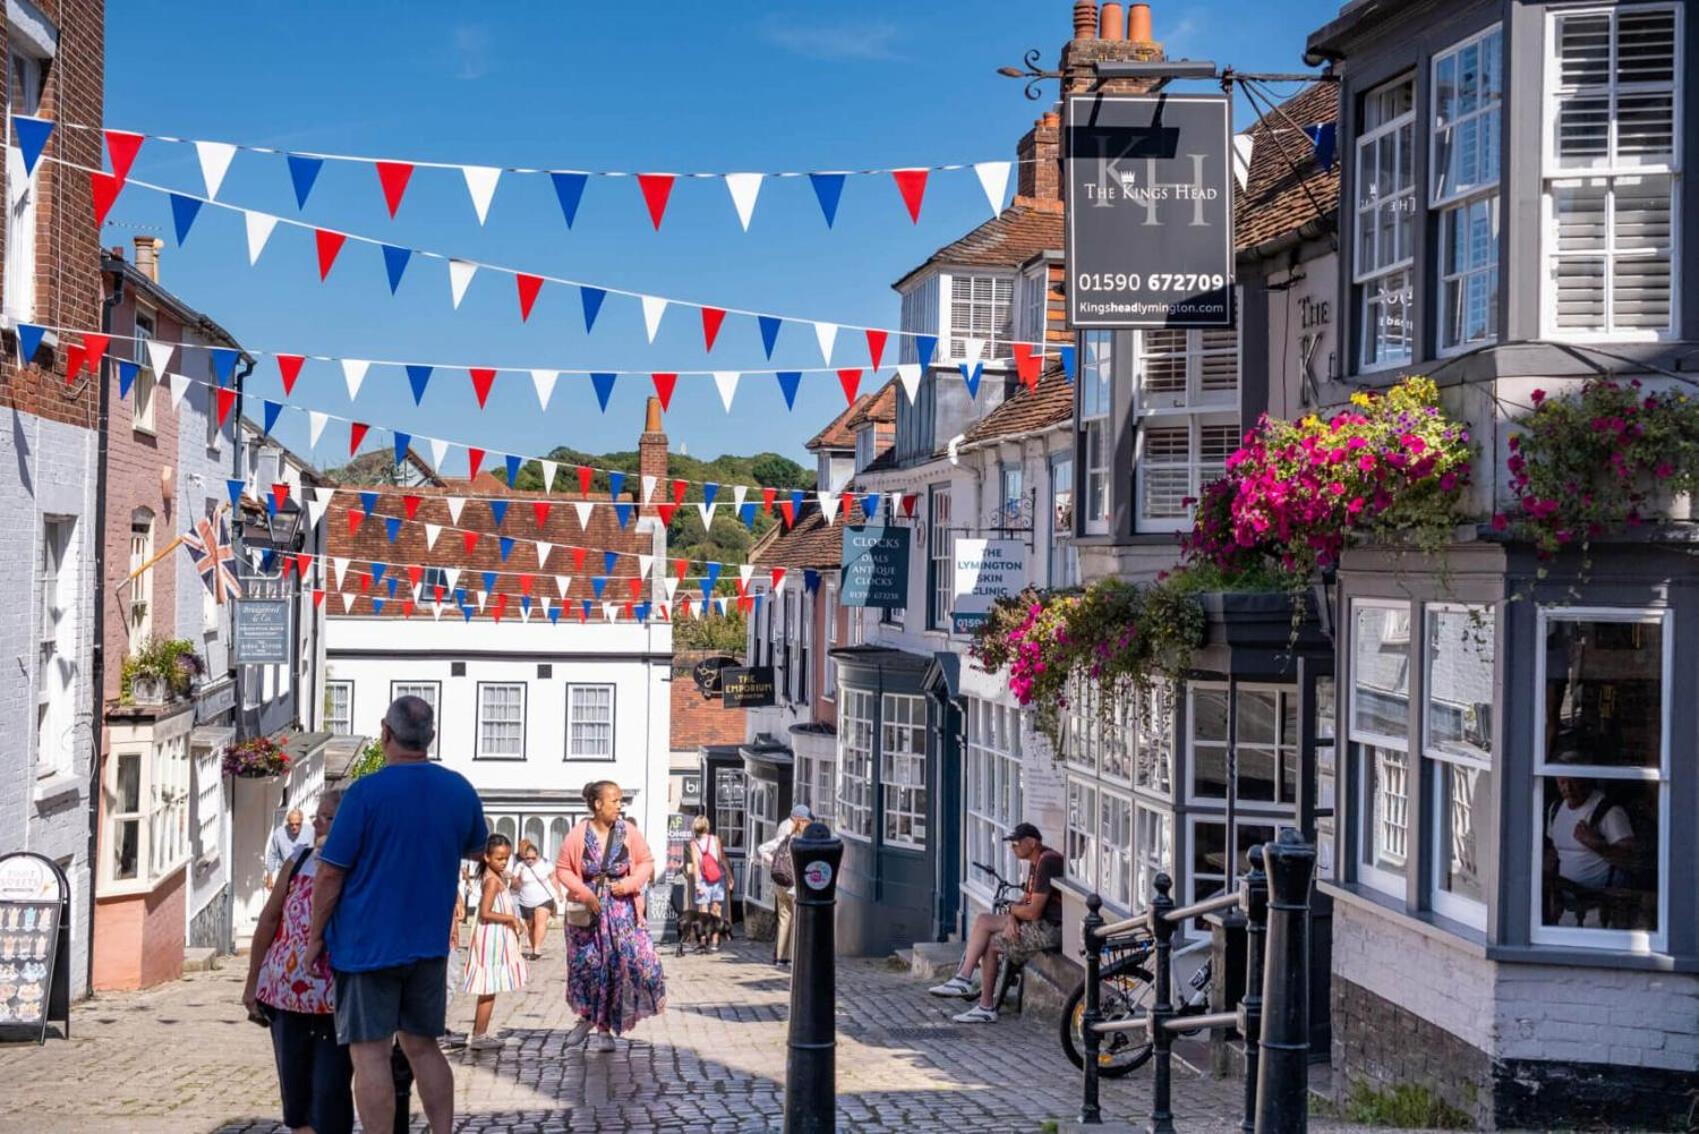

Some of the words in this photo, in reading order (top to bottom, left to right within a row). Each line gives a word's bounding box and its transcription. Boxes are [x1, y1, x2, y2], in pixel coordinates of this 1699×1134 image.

[1079, 273, 1141, 291] 01590
[1148, 273, 1224, 291] 672709
[1080, 301, 1224, 314] Kingsheadlymington.com
[1298, 295, 1331, 329] THE
[853, 537, 900, 549] CLOCKS
[982, 548, 1003, 558] THE
[958, 560, 1022, 571] LYMINGTON
[852, 566, 896, 576] ANTIQUE
[976, 574, 1003, 583] SKIN
[972, 587, 1008, 596] CLINIC
[737, 675, 756, 683] THE
[725, 683, 772, 693] EMPORIUM
